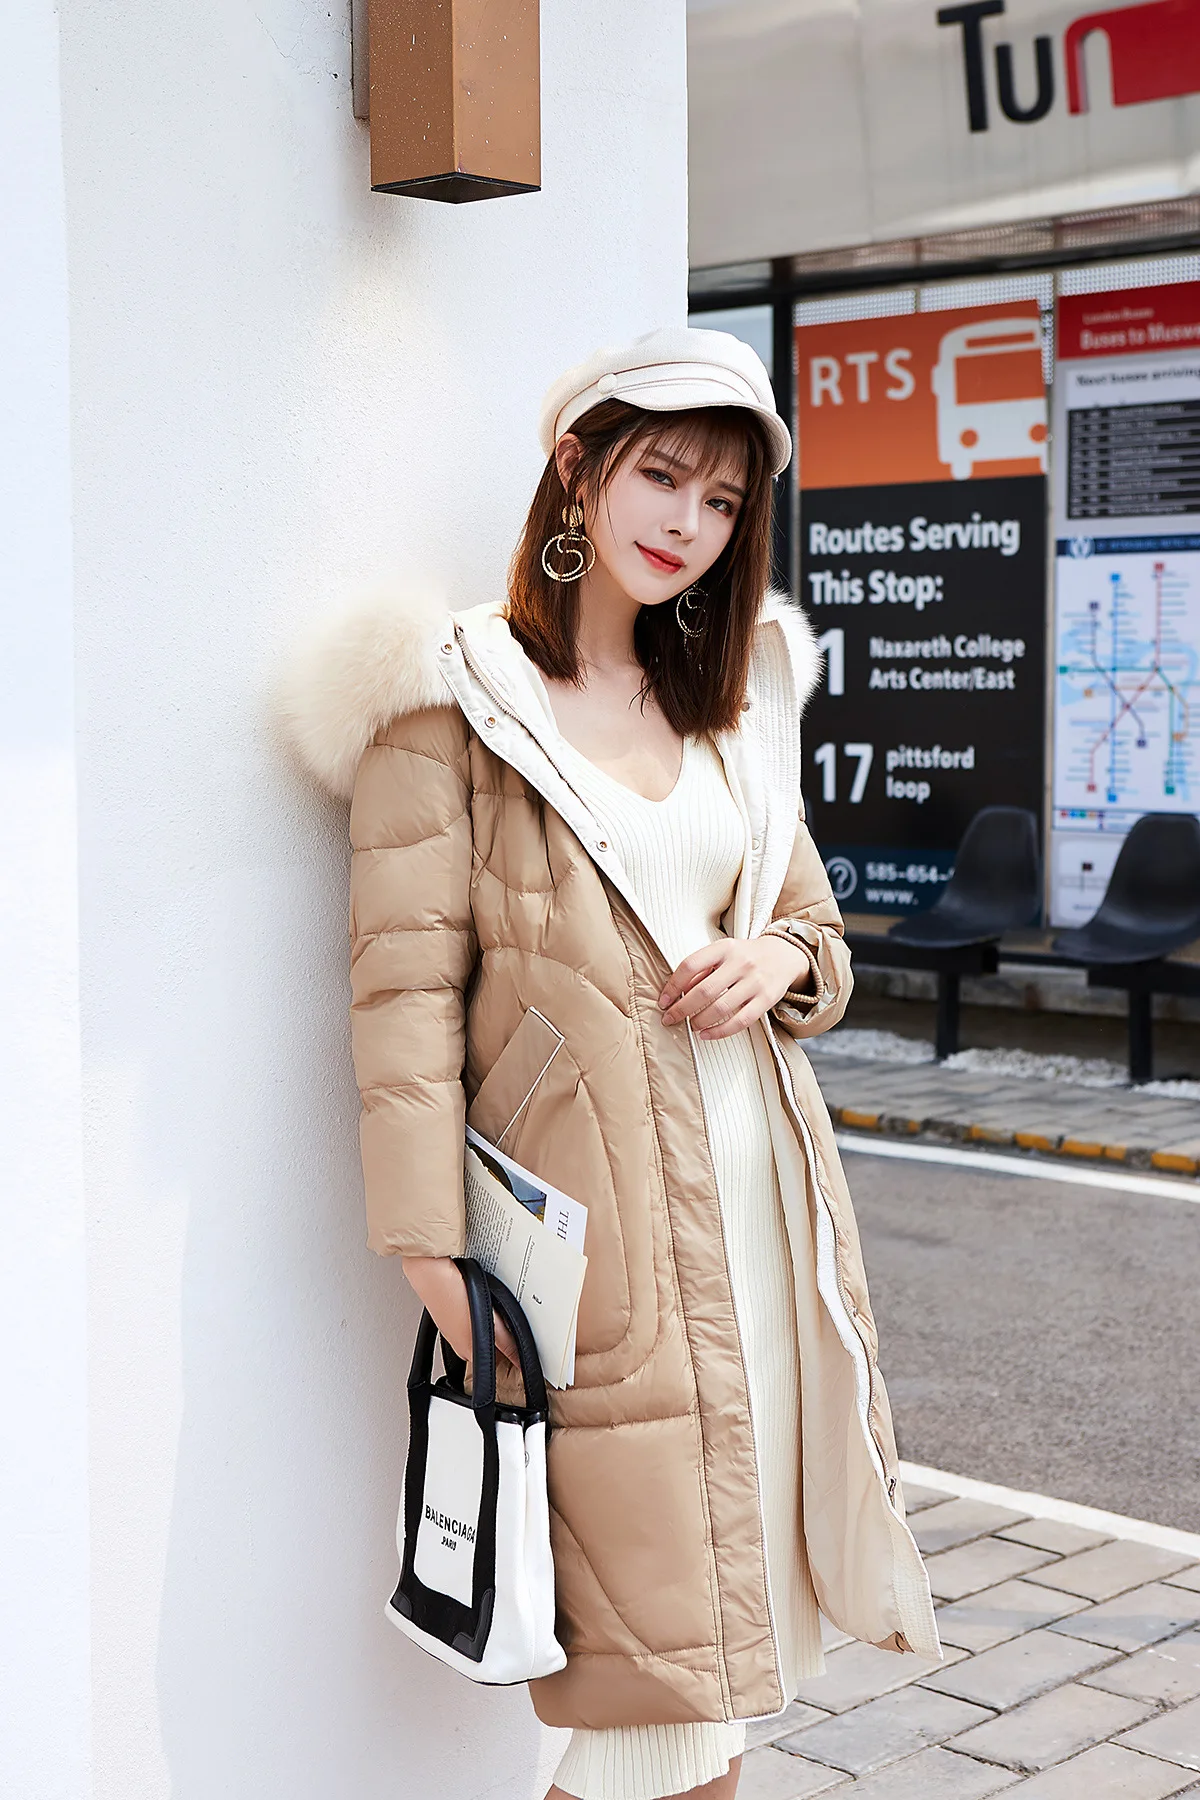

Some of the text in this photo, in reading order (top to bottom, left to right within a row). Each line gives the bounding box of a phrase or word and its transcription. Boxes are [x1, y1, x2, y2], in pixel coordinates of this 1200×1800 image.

[1080, 329, 1127, 350] Buses
[1127, 326, 1146, 345] to
[809, 346, 916, 408] RTS
[808, 511, 1021, 556] Routes Serving
[808, 569, 944, 611] This Stop:
[818, 627, 845, 696] 1
[954, 633, 1026, 663] College
[869, 666, 1016, 692] Arts Center/East
[814, 742, 874, 803] 17
[885, 744, 975, 772] pittsford
[885, 775, 931, 804] loop
[425, 1504, 476, 1544] BALENCIAGA
